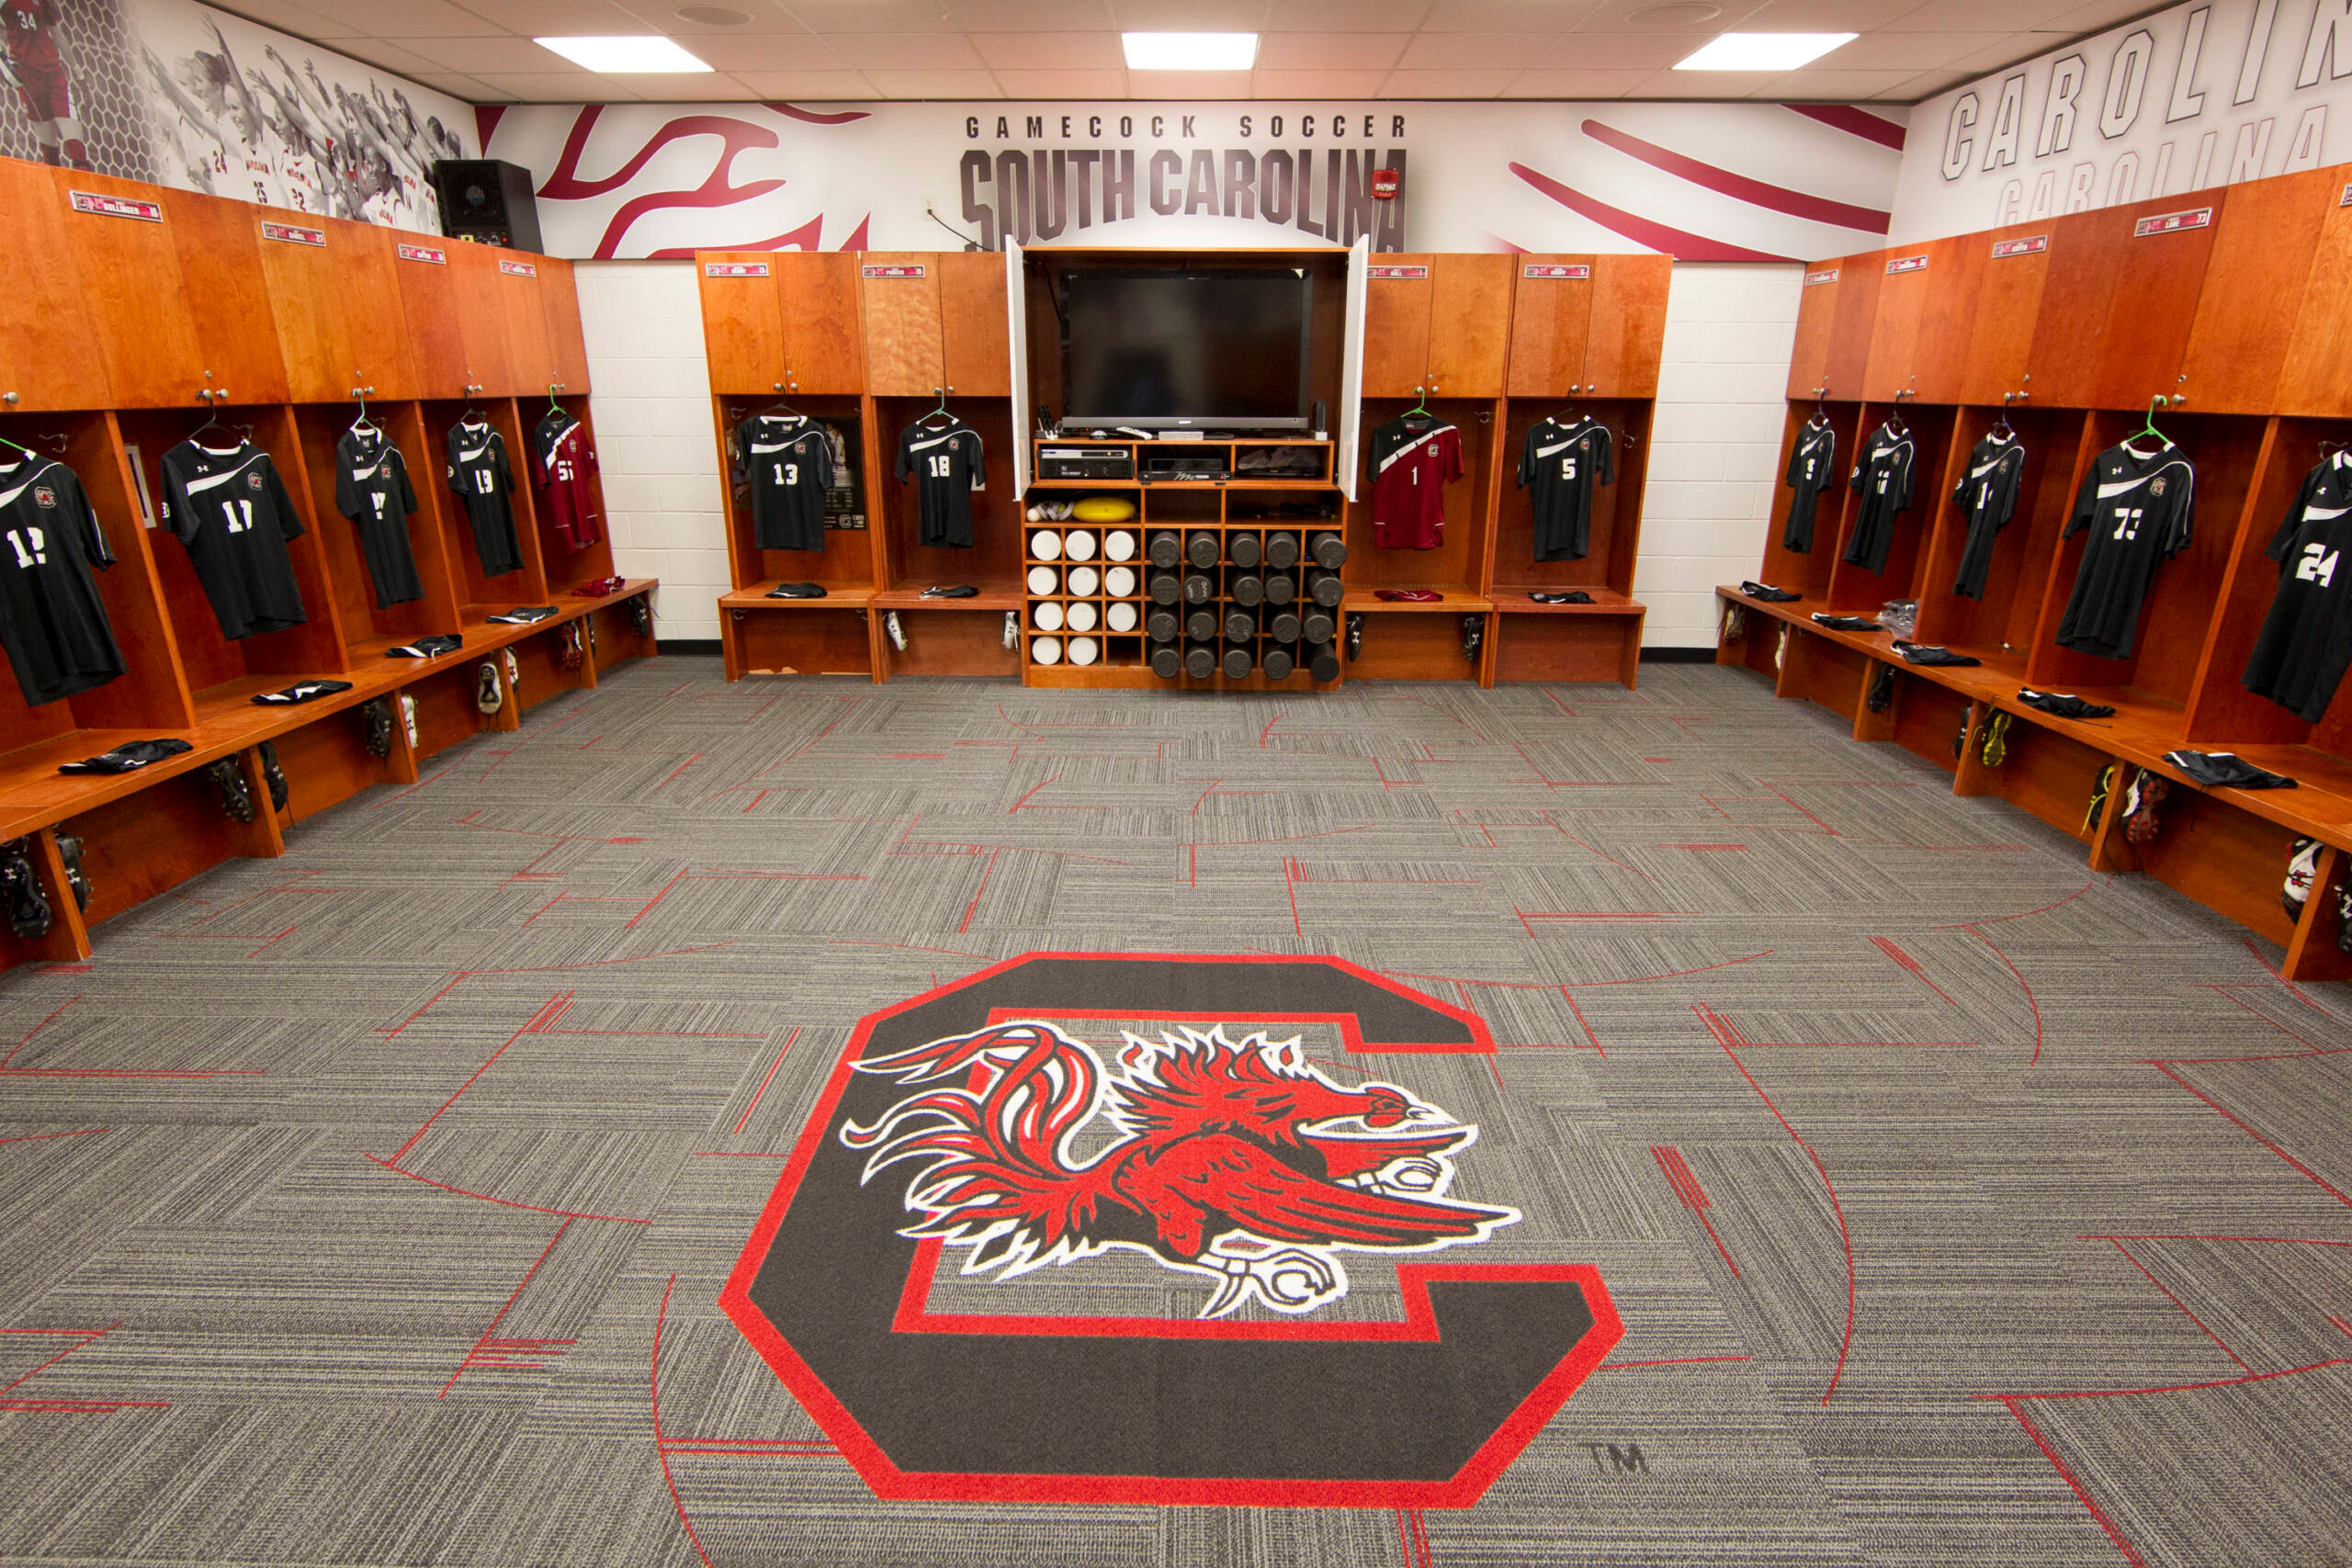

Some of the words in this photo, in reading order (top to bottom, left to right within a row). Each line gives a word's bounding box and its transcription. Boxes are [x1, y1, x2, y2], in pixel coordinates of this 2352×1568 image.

[17, 9, 37, 31] 34
[966, 116, 1196, 139] GAMECOCK
[1239, 116, 1406, 139] SOCCER
[1994, 104, 2329, 230] CAROLINA
[960, 149, 1136, 253] SOUTH
[1149, 149, 1408, 254] CAROLINA
[2197, 212, 2208, 224] 73
[774, 463, 798, 485] 13
[928, 455, 951, 478] 18
[1411, 466, 1419, 486] 1
[1562, 457, 1577, 479] 5
[2295, 542, 2341, 588] 24
[1576, 1441, 1652, 1476] TM
